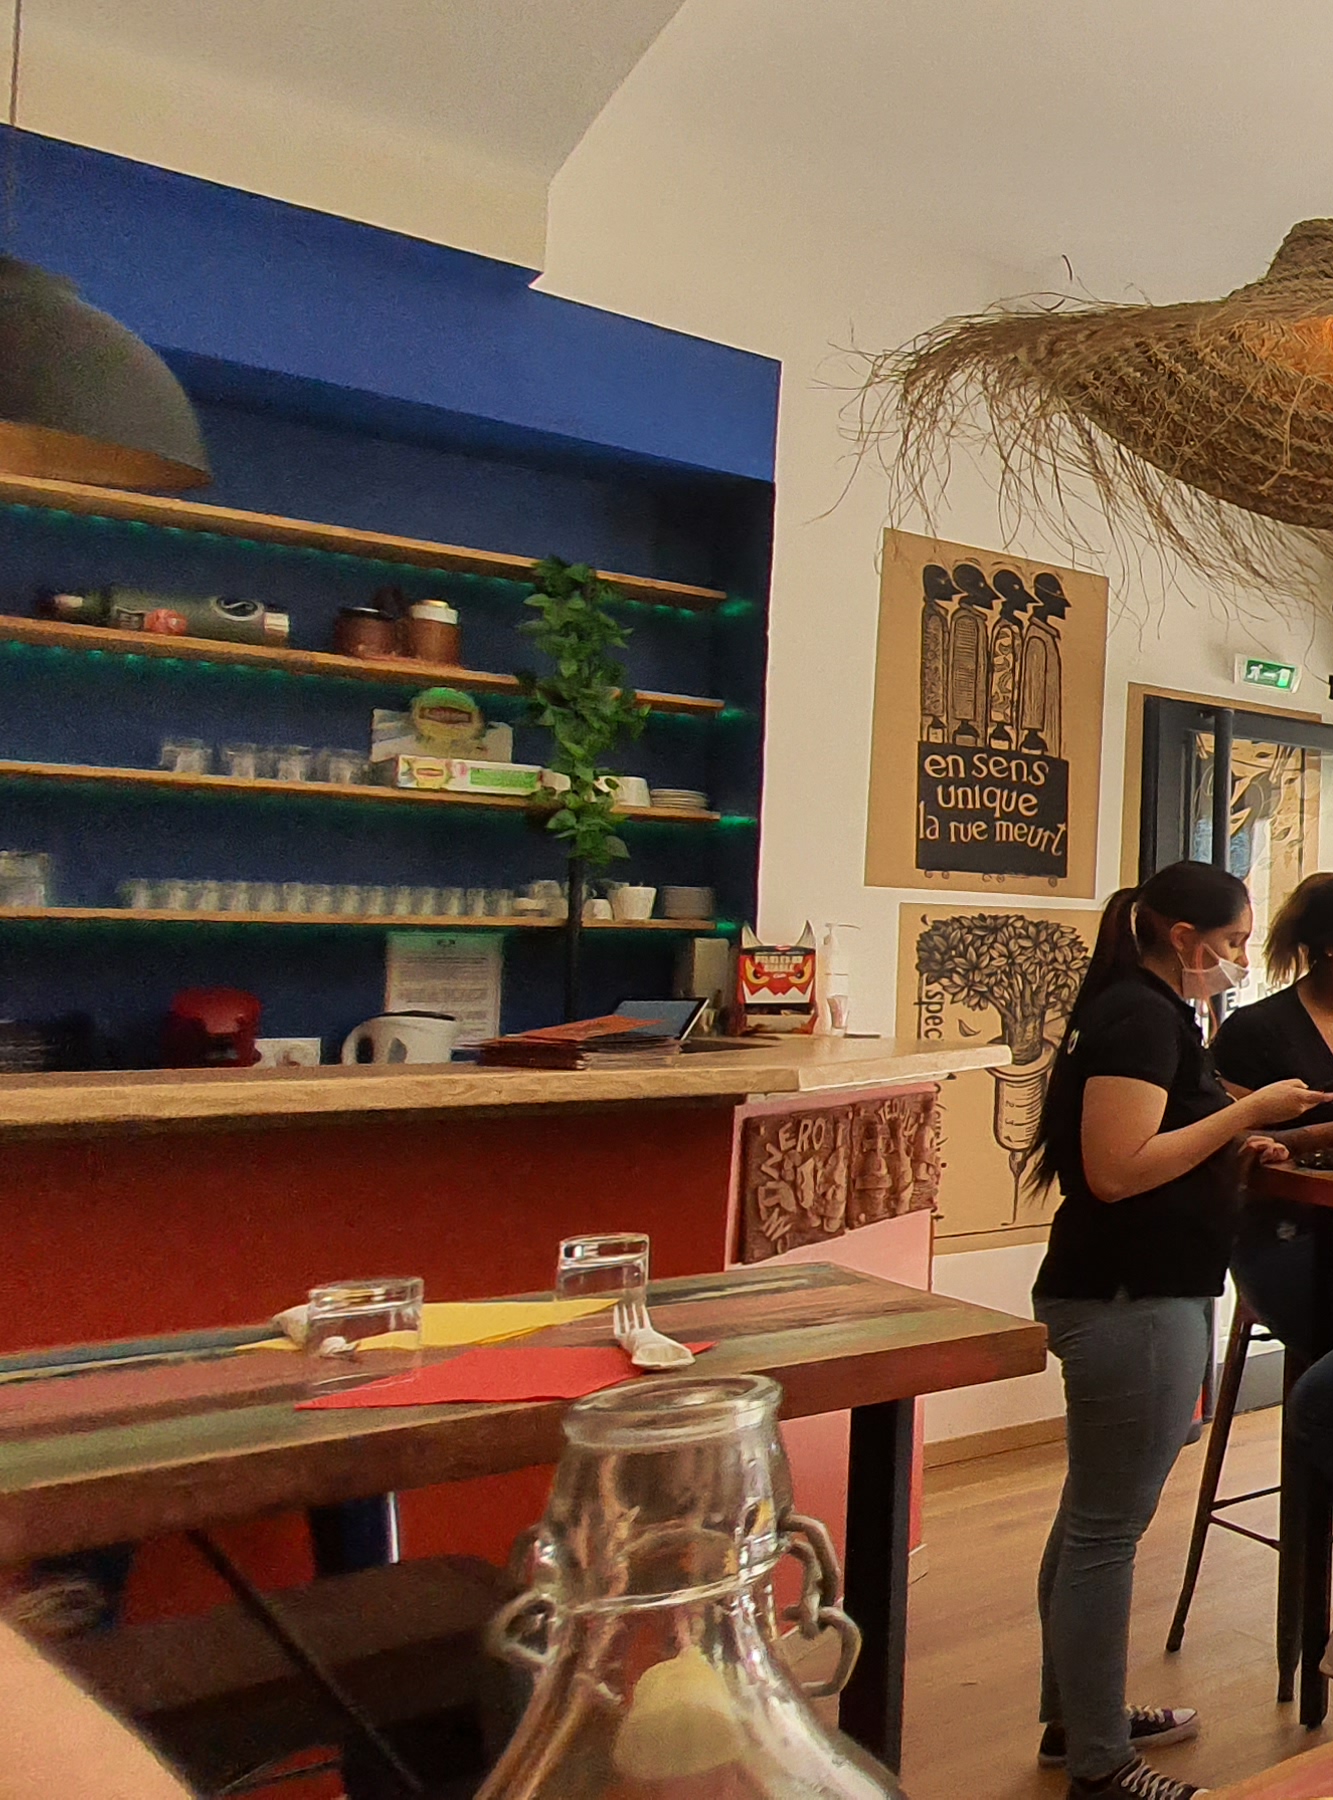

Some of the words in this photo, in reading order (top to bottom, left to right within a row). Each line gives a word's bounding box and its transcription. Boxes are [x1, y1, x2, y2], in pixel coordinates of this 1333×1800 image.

[924, 754, 965, 778] en
[971, 753, 1049, 786] sens
[936, 784, 1038, 818] unique
[919, 800, 940, 839] la
[950, 820, 988, 843] rue
[995, 819, 1067, 856] meurt
[914, 990, 944, 1040] spec
